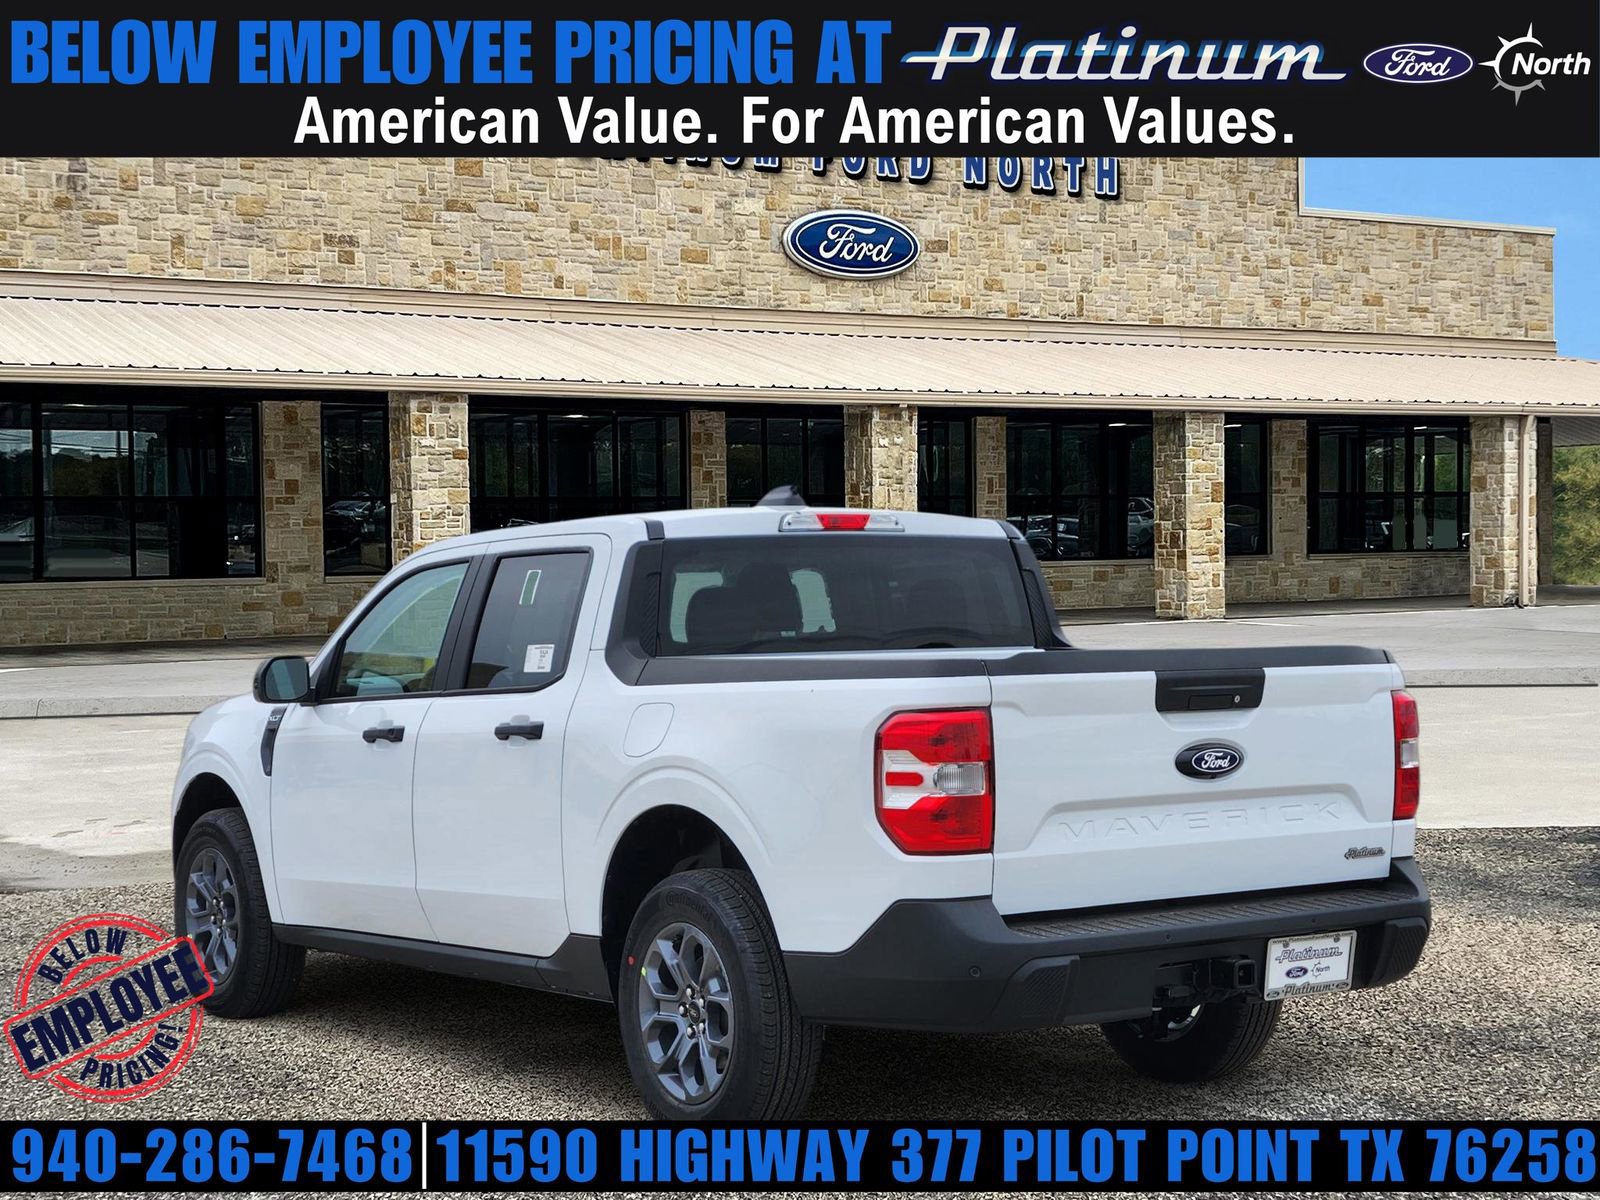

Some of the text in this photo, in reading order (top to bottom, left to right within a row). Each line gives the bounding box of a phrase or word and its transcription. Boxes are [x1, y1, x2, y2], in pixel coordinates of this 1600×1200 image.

[963, 157, 1120, 197] NORTH
[819, 223, 894, 262] Ford
[1201, 752, 1231, 769] Ford
[1059, 800, 1340, 840] MAVERICK
[1275, 946, 1343, 964] Platinum
